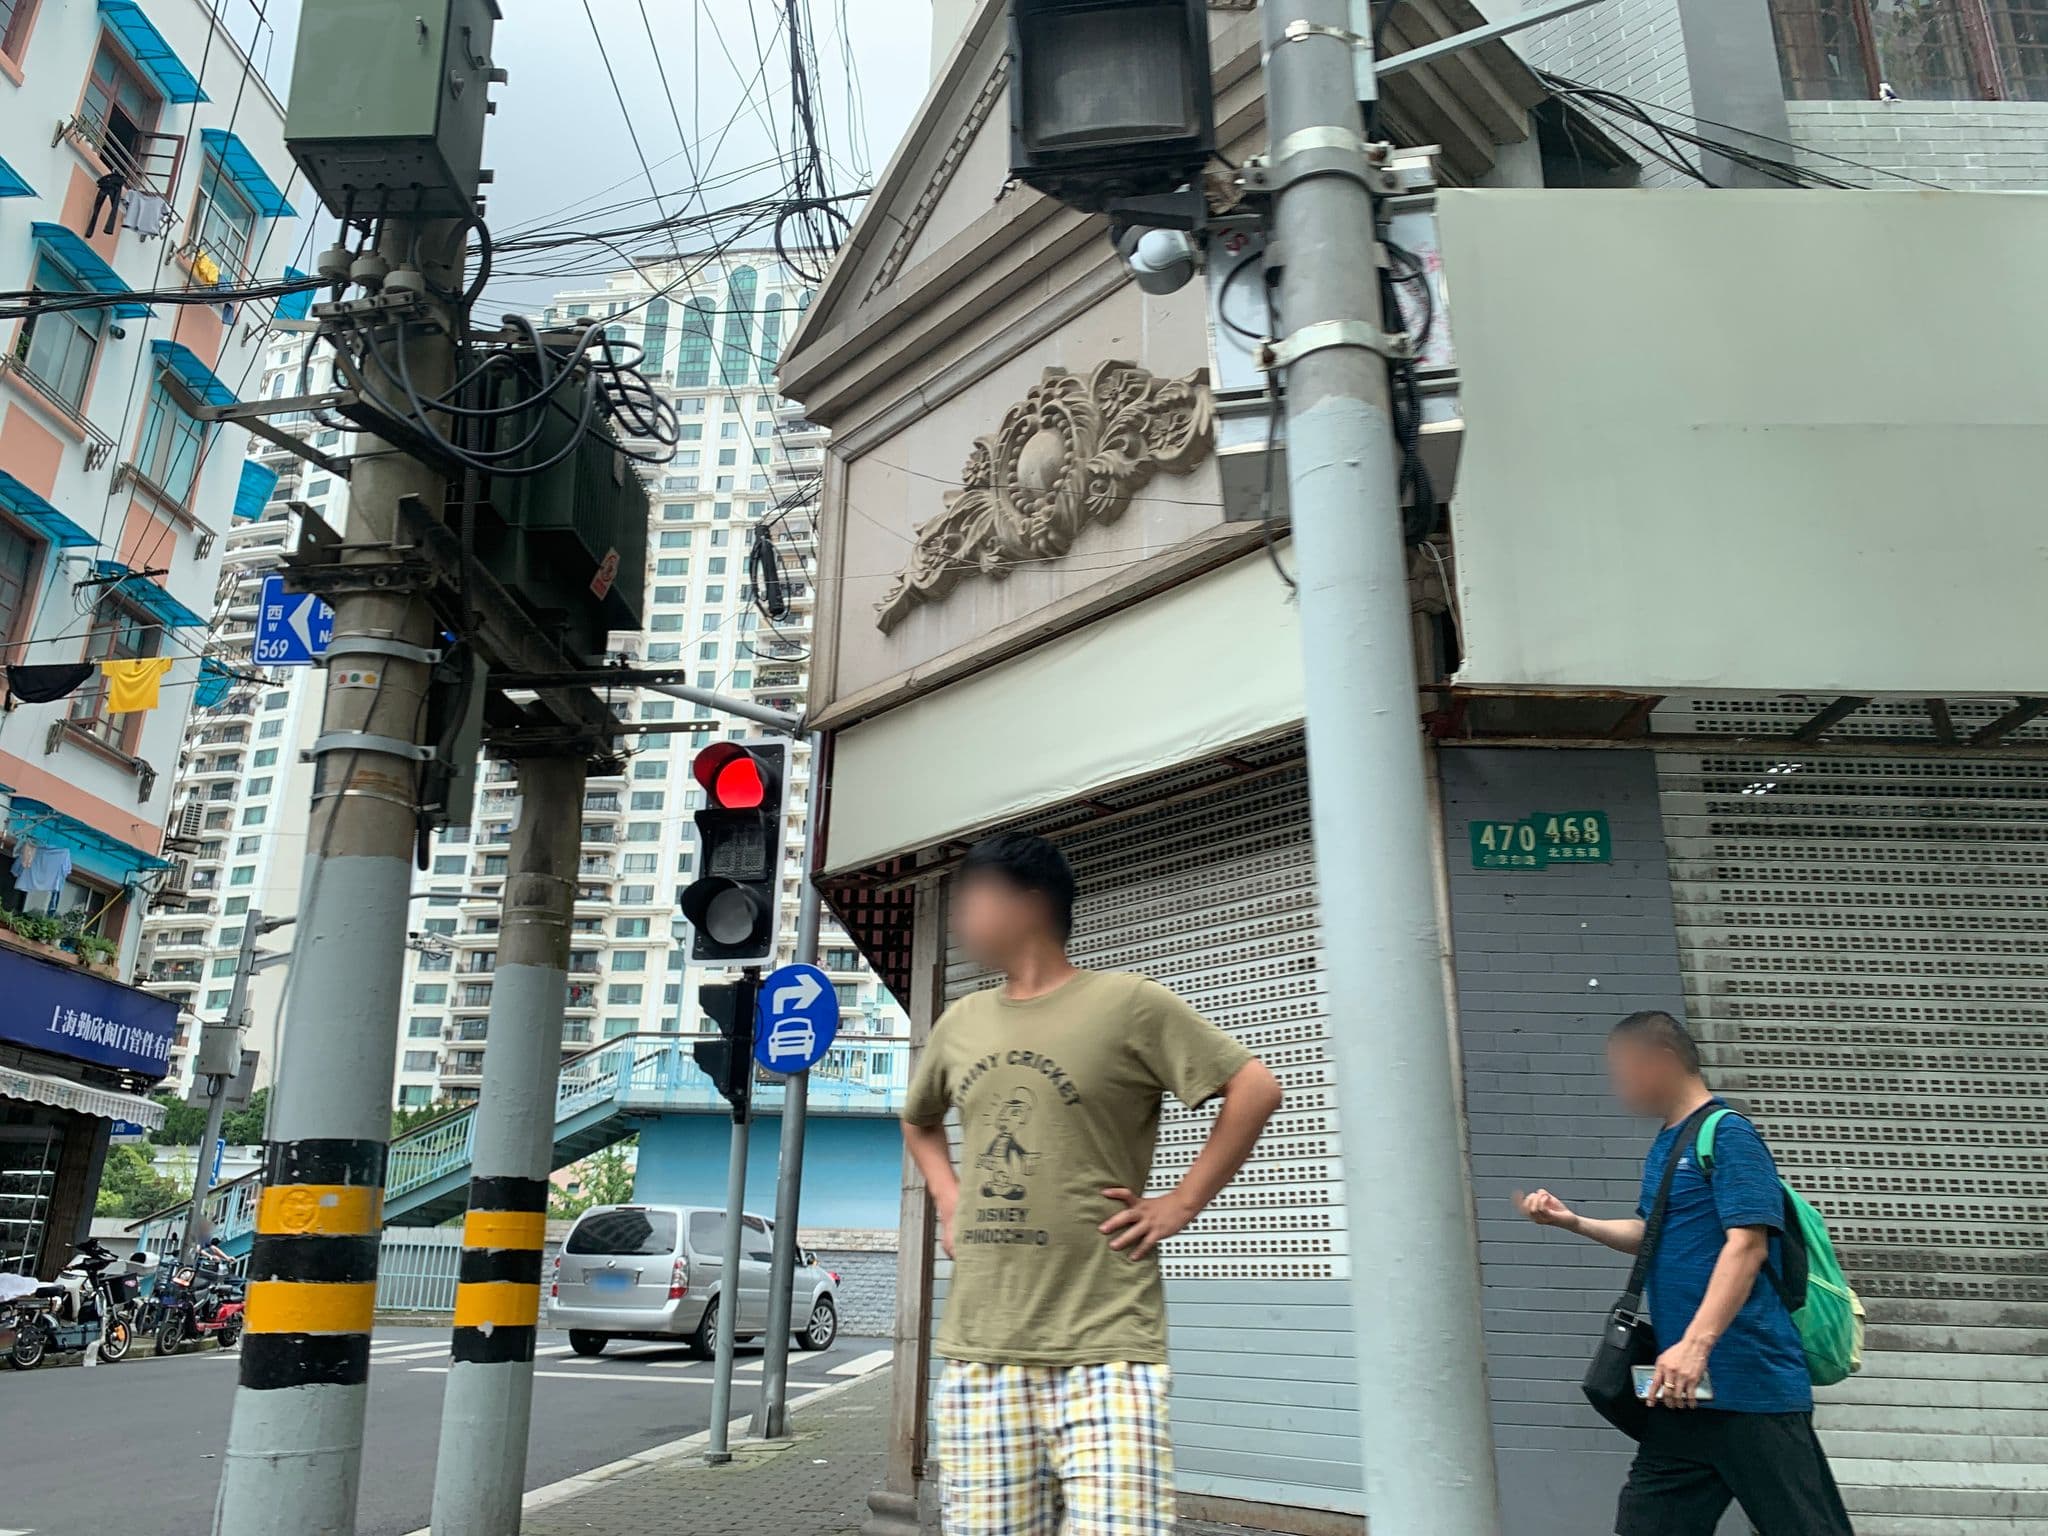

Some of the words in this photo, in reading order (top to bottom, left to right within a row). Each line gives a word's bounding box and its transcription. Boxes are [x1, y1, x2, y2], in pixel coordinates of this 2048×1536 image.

[268, 622, 279, 632] W
[259, 639, 289, 658] 569
[1480, 824, 1537, 851] 470
[1544, 817, 1601, 844] 468
[1006, 1050, 1082, 1106] CRICKET
[975, 1207, 1031, 1223] DISNEY
